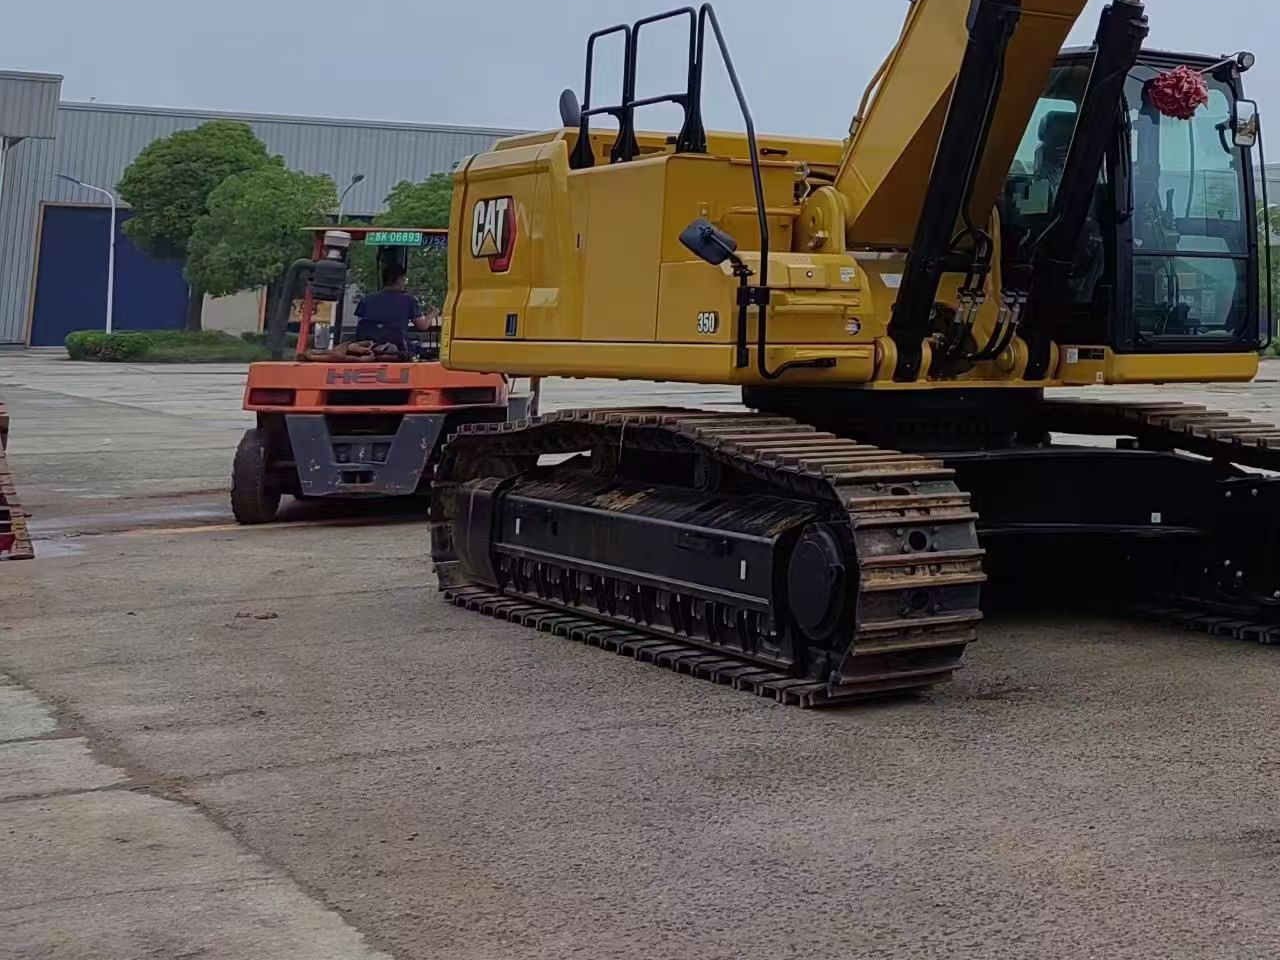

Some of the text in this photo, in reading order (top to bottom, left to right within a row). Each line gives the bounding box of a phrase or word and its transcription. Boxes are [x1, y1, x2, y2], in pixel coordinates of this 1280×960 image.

[472, 198, 509, 256] CAT
[697, 312, 715, 332] 350
[326, 367, 411, 384] HELI
